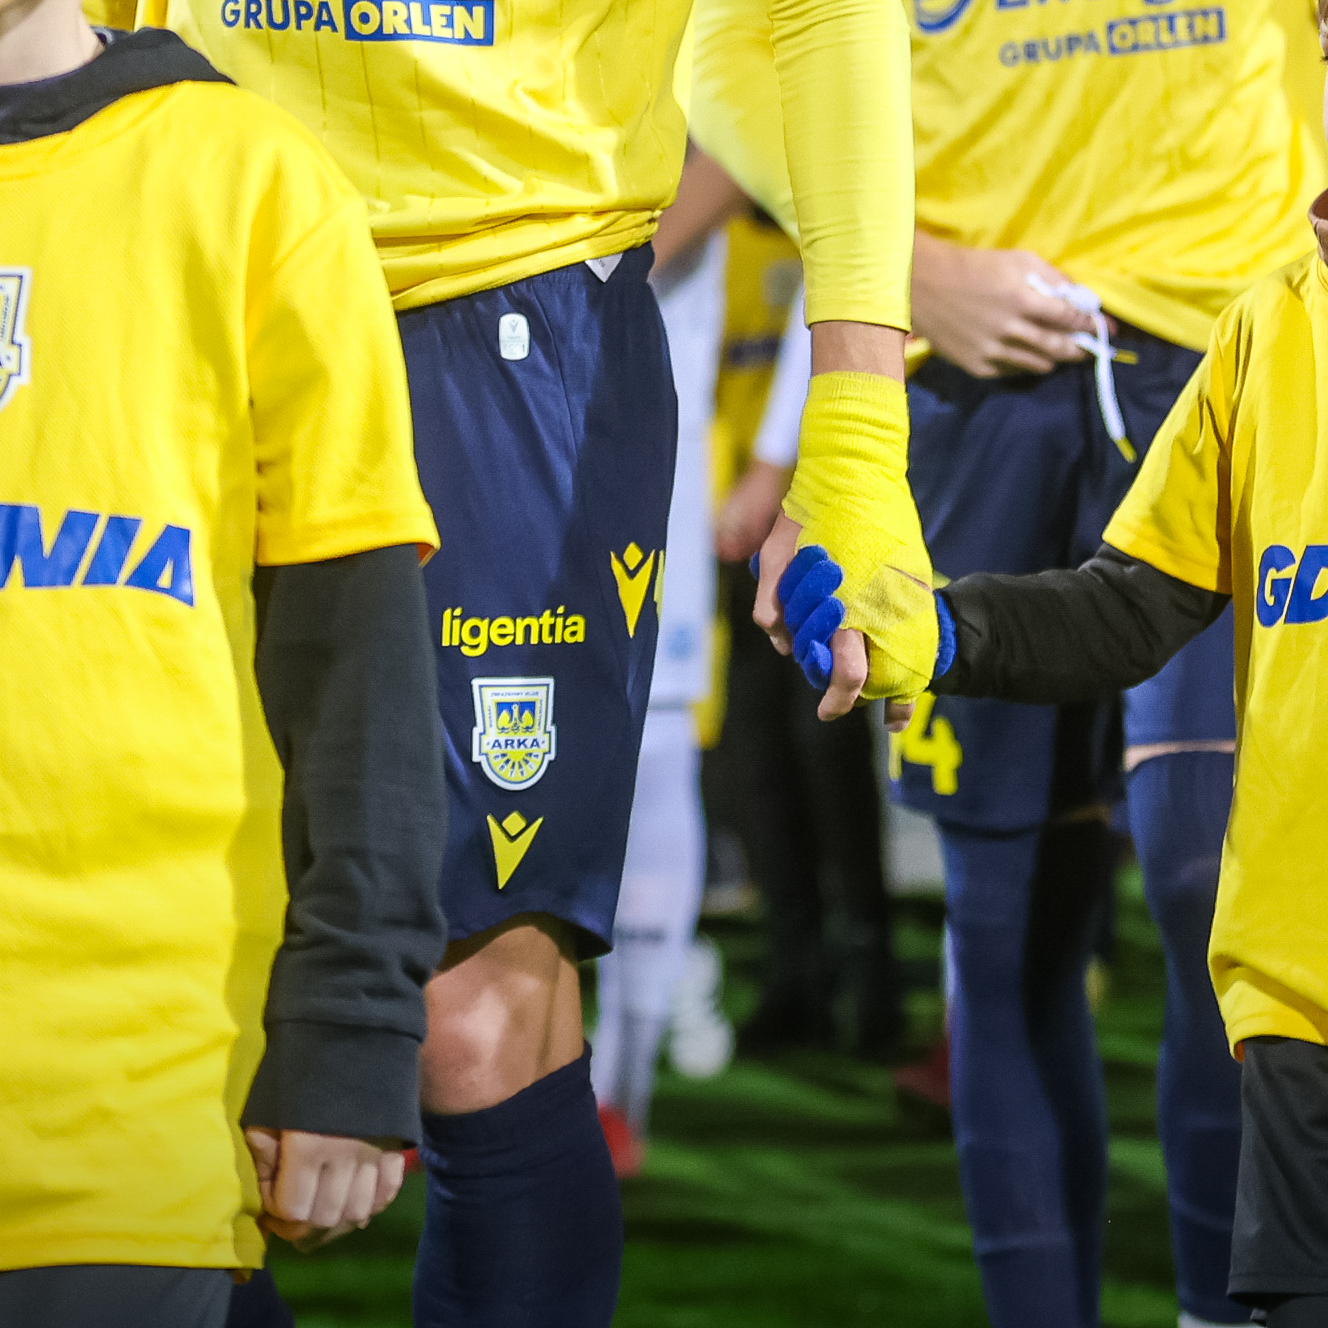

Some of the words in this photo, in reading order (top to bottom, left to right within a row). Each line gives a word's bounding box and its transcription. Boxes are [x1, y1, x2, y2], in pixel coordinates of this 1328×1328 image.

[349, 0, 486, 40] ORLEN
[998, 30, 1102, 68] GRUPA
[1111, 11, 1219, 48] ORLEN
[441, 605, 586, 657] ligentia
[491, 738, 541, 750] ARKA
